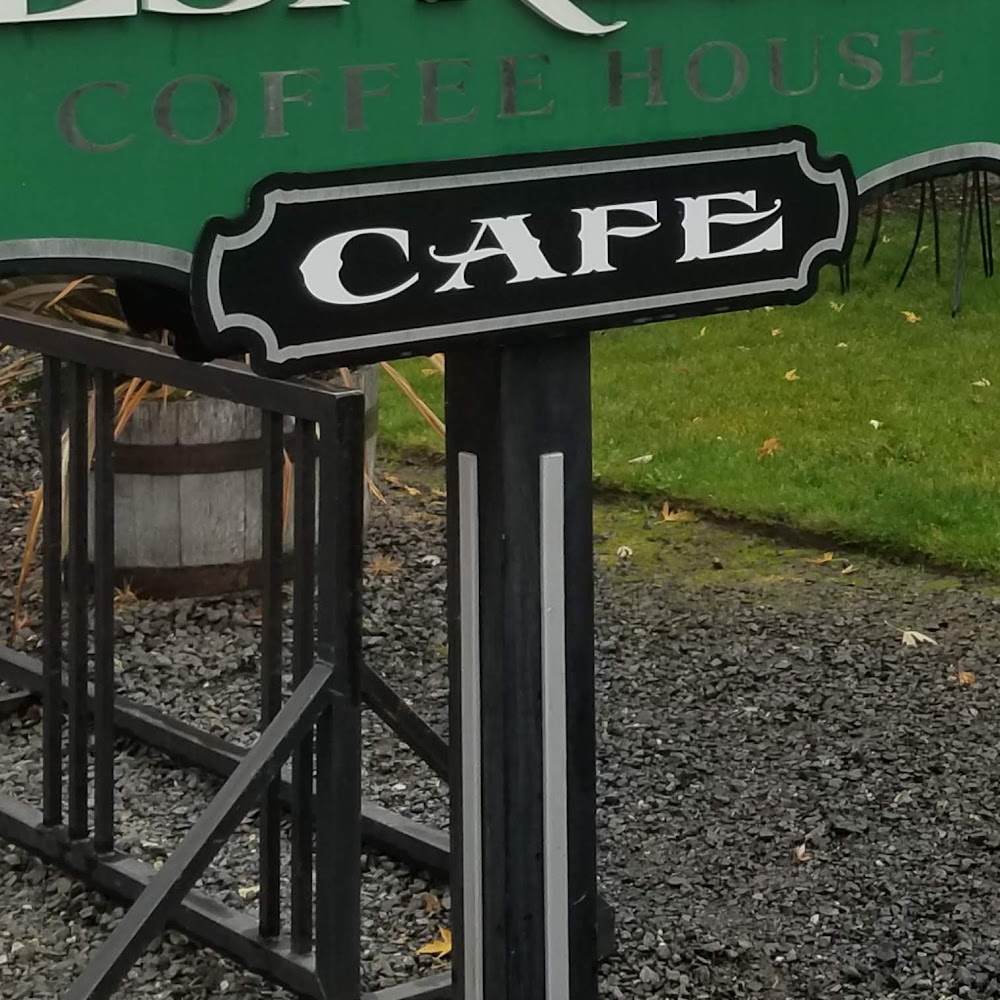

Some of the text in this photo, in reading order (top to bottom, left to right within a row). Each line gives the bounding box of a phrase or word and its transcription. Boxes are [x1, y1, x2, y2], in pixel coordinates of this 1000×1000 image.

[56, 28, 946, 153] COFFEE HOUSE
[299, 190, 784, 306] CAFE
